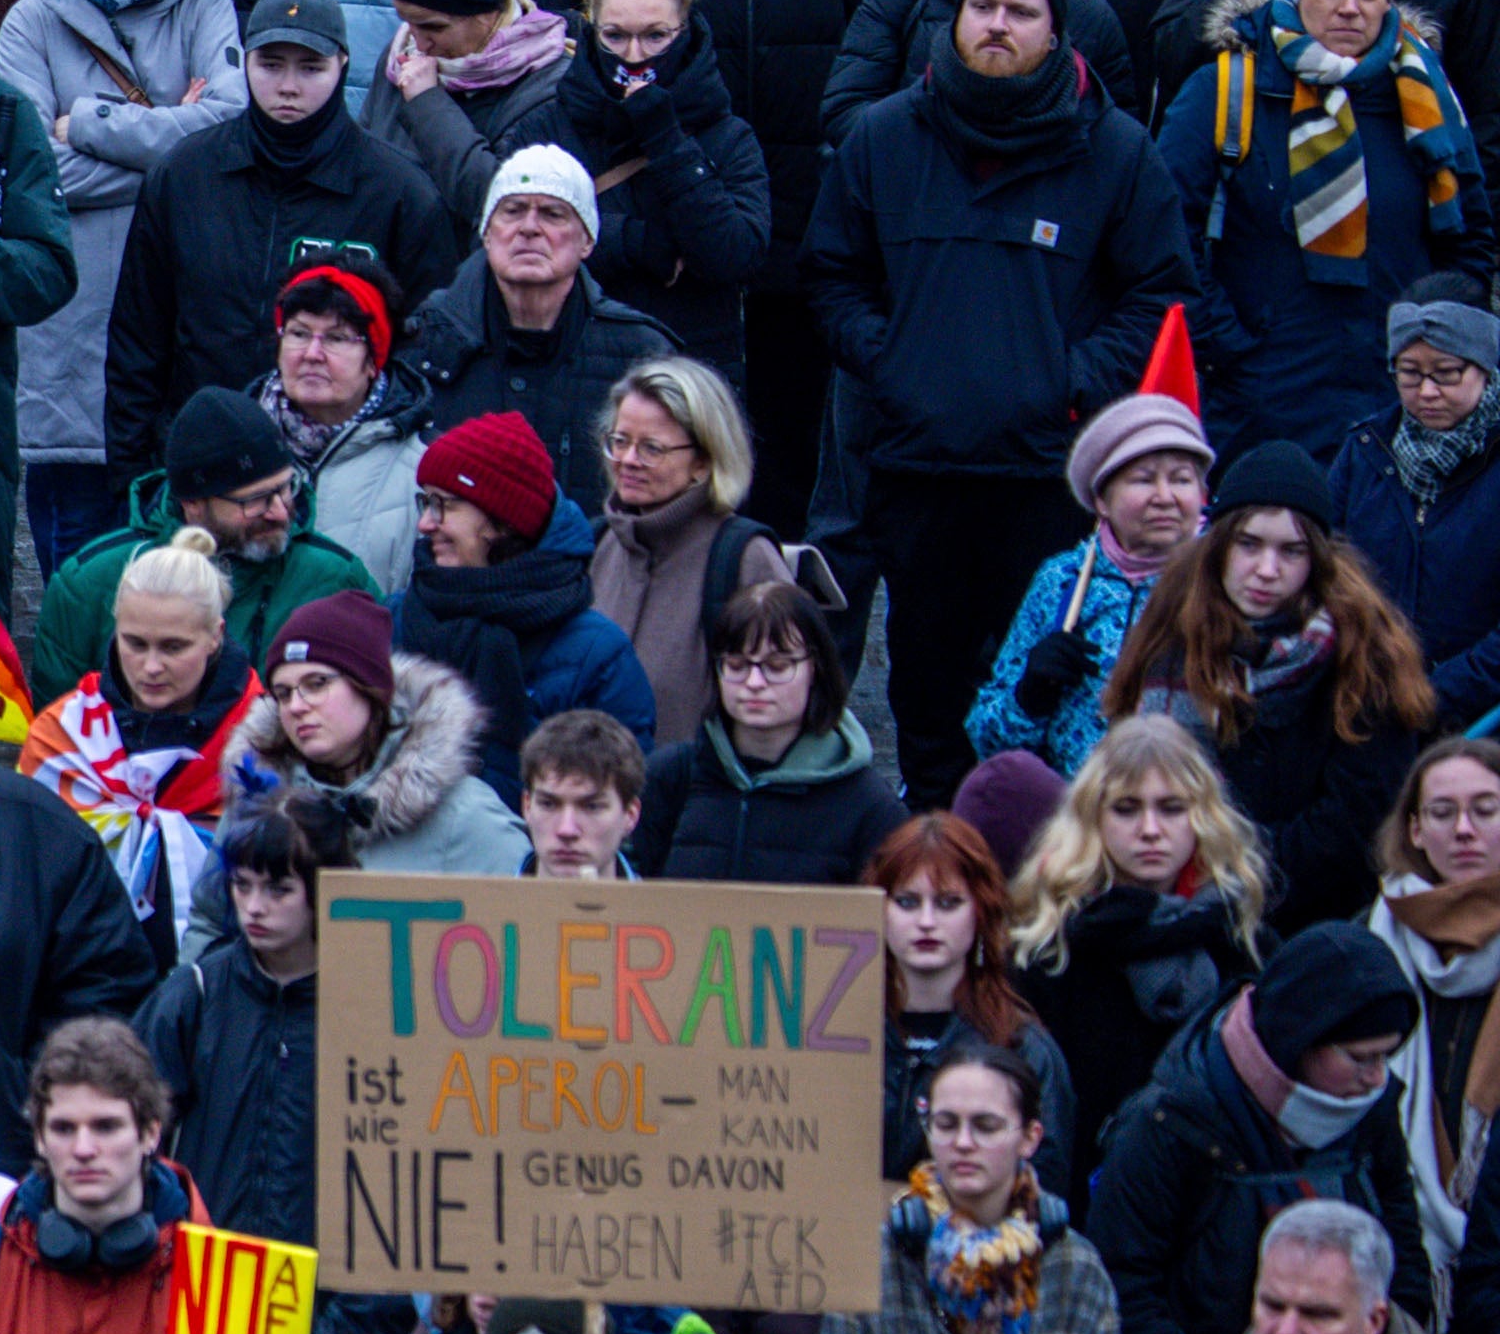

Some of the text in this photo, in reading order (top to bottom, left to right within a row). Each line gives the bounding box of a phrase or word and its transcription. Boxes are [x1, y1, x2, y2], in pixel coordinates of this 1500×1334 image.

[329, 898, 878, 1053] TOLERANZ
[347, 1056, 406, 1106] ist
[718, 1066, 791, 1103] MAN
[720, 1114, 820, 1153] KANN
[524, 1152, 642, 1189] GENUG
[668, 1156, 785, 1192] DAVON
[531, 1214, 683, 1282] HABEN
